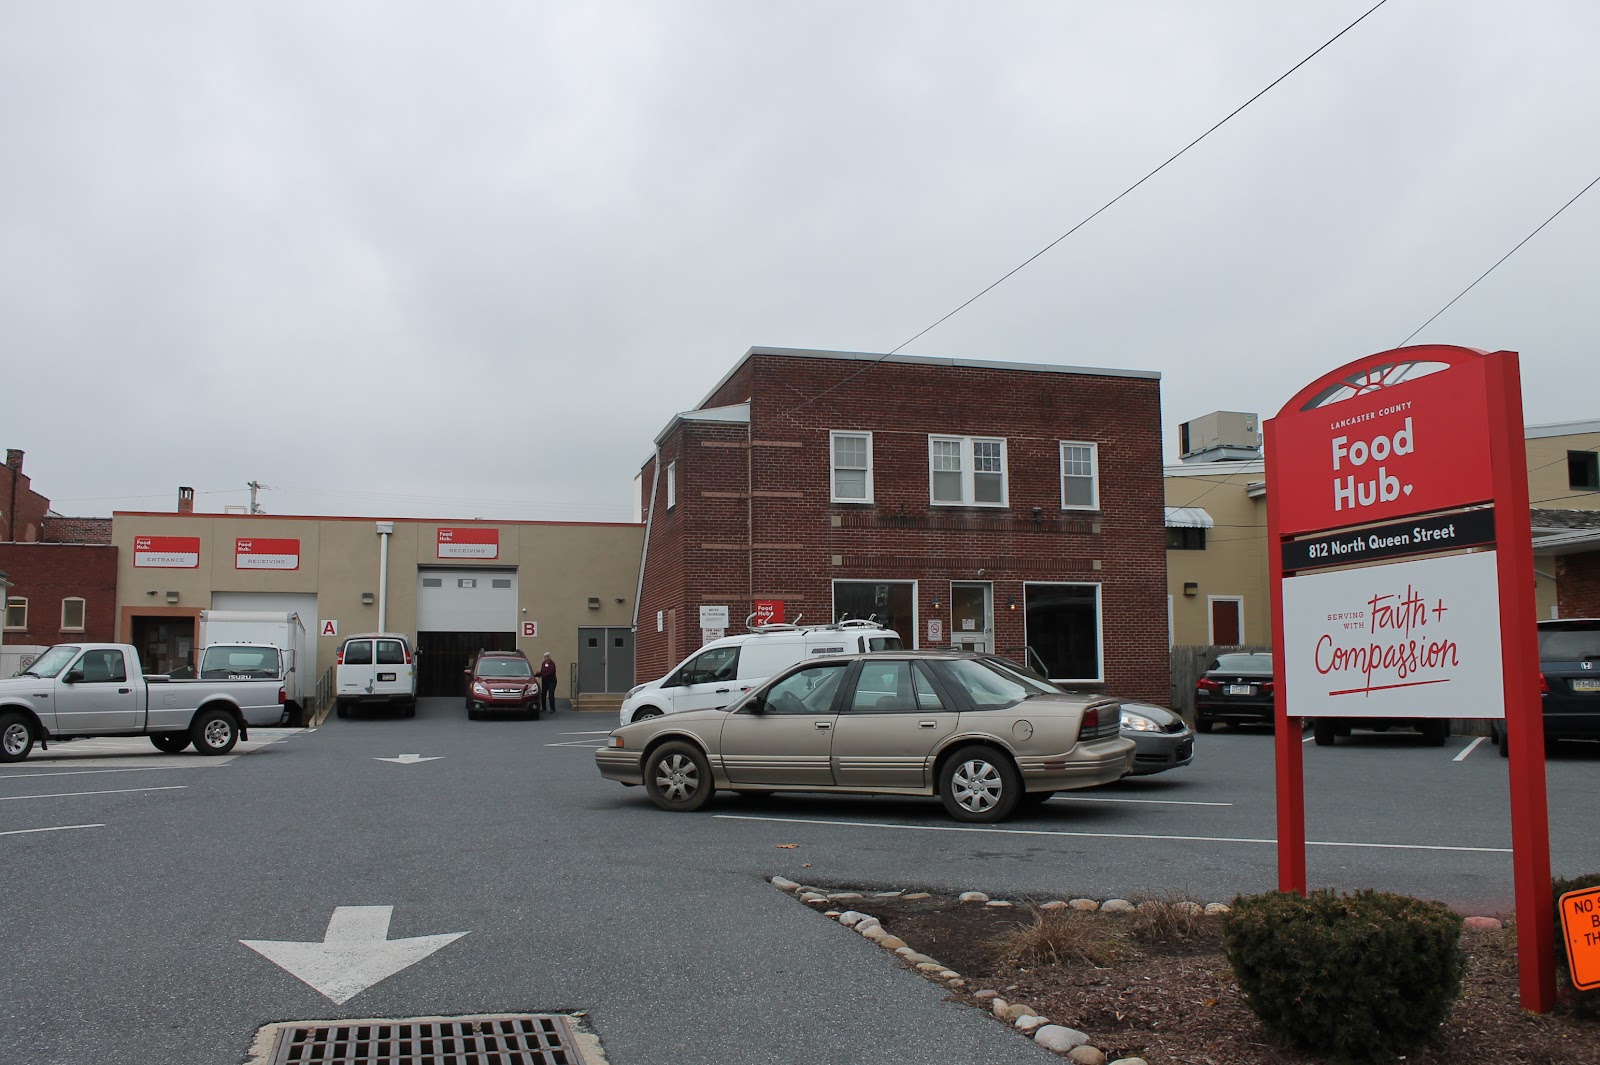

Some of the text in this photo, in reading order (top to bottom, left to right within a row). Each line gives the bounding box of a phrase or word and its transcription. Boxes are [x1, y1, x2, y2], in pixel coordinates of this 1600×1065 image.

[1330, 401, 1412, 430] LANCASTER COUNTY
[1332, 416, 1414, 471] Food
[1333, 466, 1400, 511] Hub
[1309, 524, 1456, 558] 812 North Queen Street
[1327, 611, 1364, 621] SERVING
[1343, 621, 1365, 630] WITH
[1367, 584, 1449, 639] Faith +
[323, 621, 335, 634] A
[524, 622, 535, 635] B
[1315, 634, 1459, 698] Compassion
[1574, 899, 1593, 914] NO
